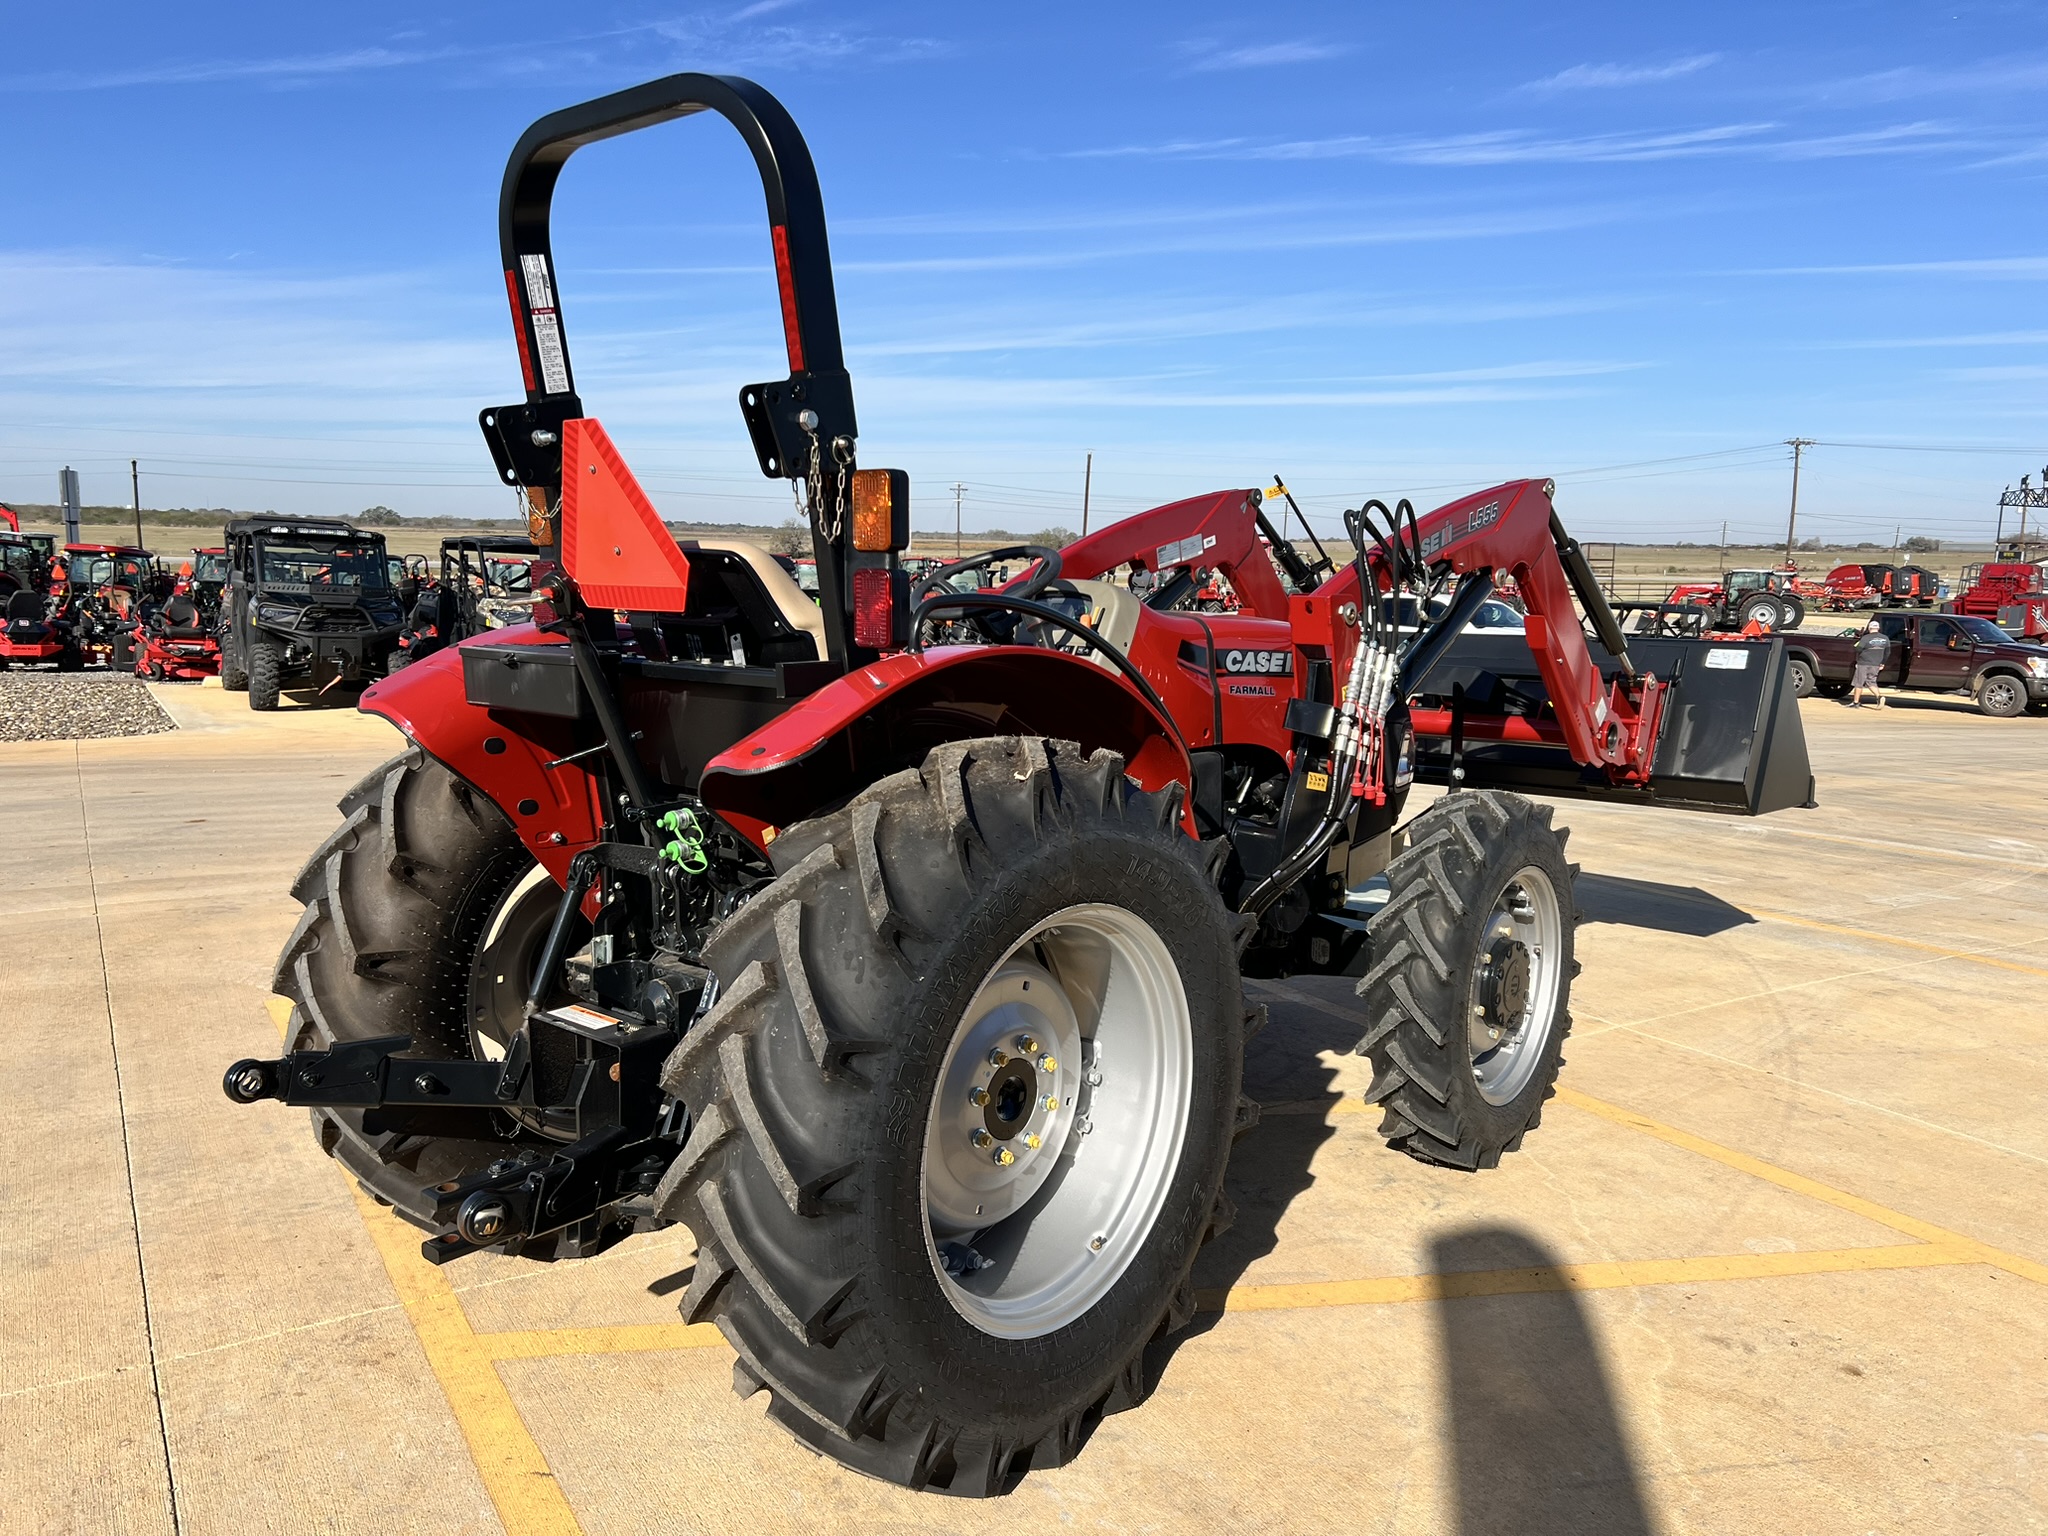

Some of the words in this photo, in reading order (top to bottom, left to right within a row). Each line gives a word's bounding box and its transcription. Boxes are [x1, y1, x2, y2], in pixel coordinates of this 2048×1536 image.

[1468, 502, 1499, 532] L555
[1225, 650, 1285, 673] CASE
[1229, 685, 1276, 696] FARMALL
